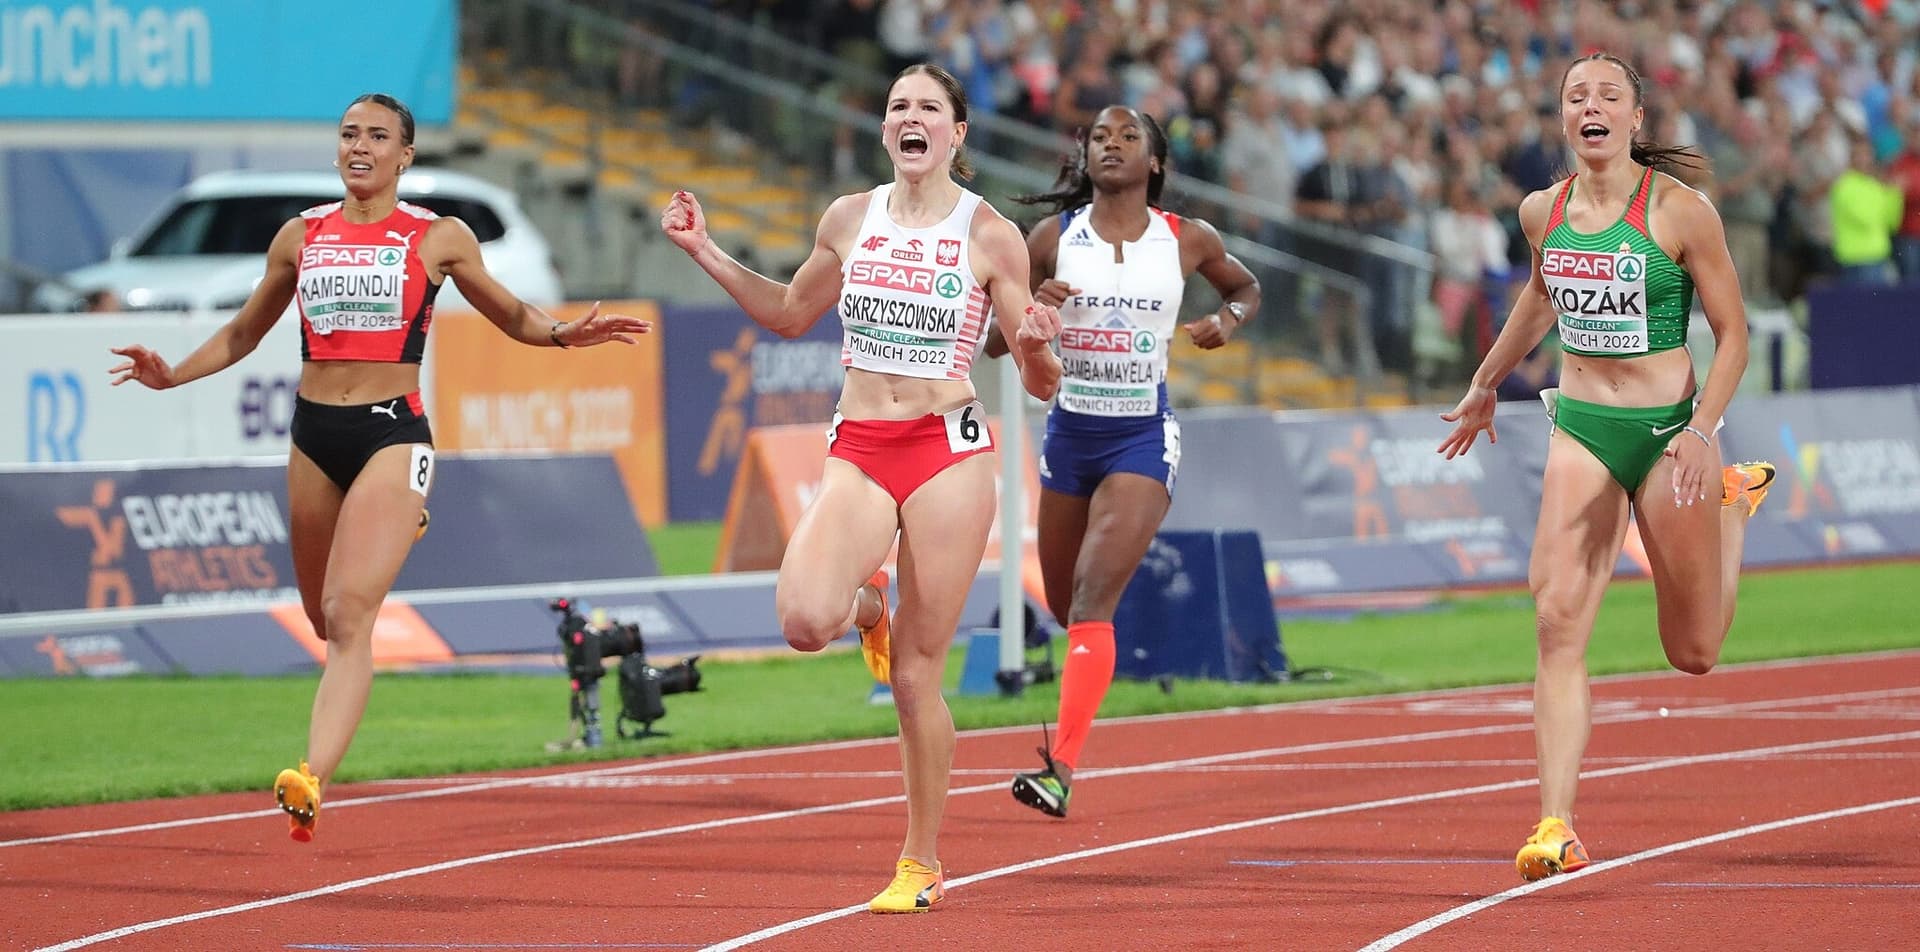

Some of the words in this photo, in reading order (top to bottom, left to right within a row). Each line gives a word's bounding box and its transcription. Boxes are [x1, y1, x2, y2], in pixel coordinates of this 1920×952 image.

[861, 235, 889, 251] 4F
[302, 249, 375, 267] SPAR
[893, 250, 922, 261] ORLEN
[1544, 254, 1612, 277] SPAR
[301, 274, 398, 302] KAMBUNDJI
[851, 264, 932, 291] SPAR
[343, 303, 374, 311] CLEAN
[1074, 296, 1162, 311] FRANCE
[1548, 285, 1642, 315] KOZÁK
[312, 314, 355, 331] MUNCH
[361, 315, 396, 327] 2022
[844, 293, 956, 334] SKRZYSZOWSKA
[870, 330, 891, 342] RUN
[893, 333, 926, 345] CLEAN
[1560, 325, 1598, 348] MUNICH
[1603, 335, 1640, 348] 2022
[1586, 321, 1616, 331] CLEAN
[850, 335, 903, 361] MUNICH
[909, 349, 946, 365] 2022
[1062, 329, 1129, 351] SPAR
[1062, 357, 1154, 384] SAMBA-MAYÉLA
[1063, 395, 1113, 412] MUNICH
[1118, 399, 1151, 412] 2022
[960, 406, 980, 443] 6
[417, 455, 429, 488] 8
[122, 491, 288, 550] EUROPEAN
